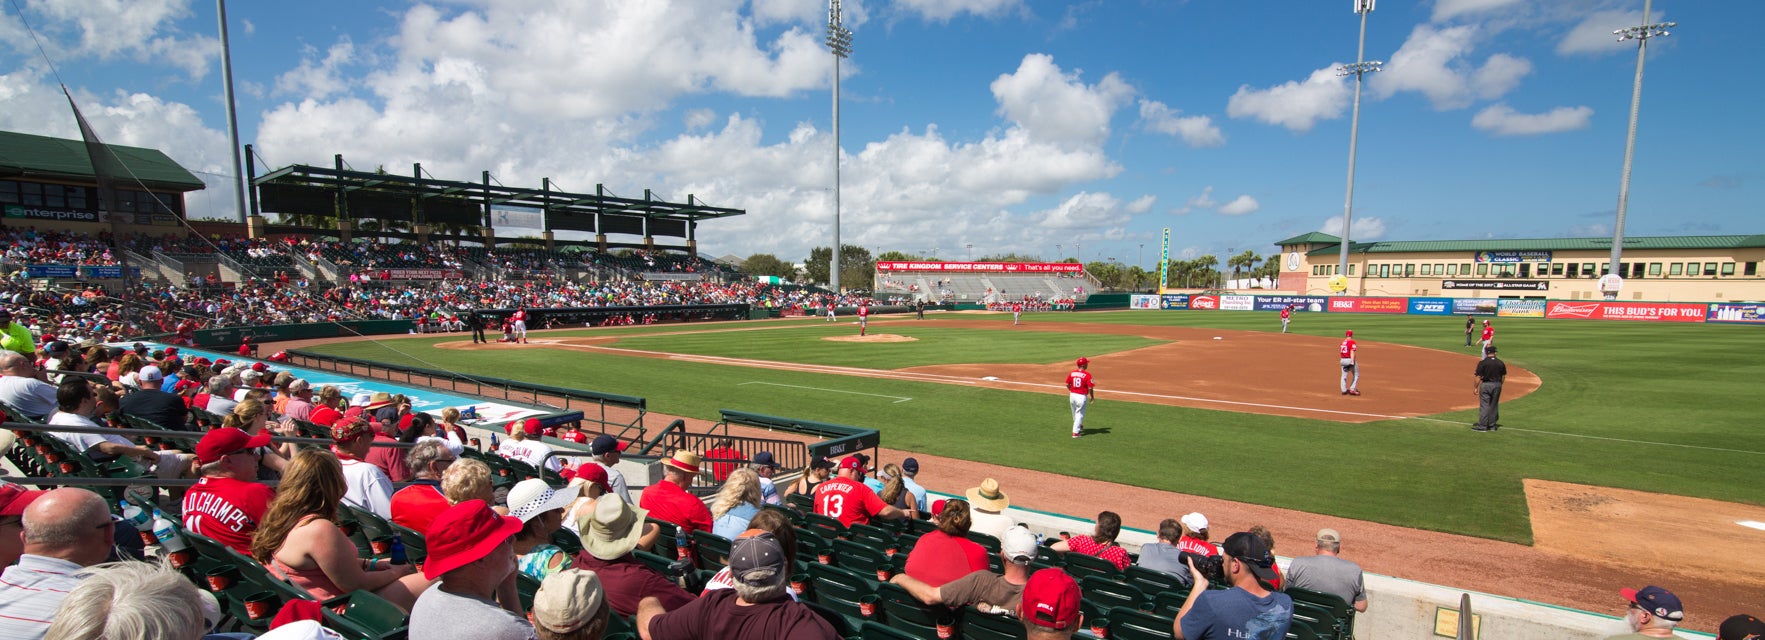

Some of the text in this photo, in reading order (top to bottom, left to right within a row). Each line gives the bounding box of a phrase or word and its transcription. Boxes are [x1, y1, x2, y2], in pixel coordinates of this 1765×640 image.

[6, 206, 95, 220] enterprise
[1554, 304, 1593, 313] Budweiser
[1603, 306, 1704, 317] THIS BUD'S FOR YOU.
[1073, 377, 1081, 388] 18
[830, 443, 846, 455] BB&T
[820, 482, 853, 494] CARPENTER
[196, 492, 248, 532] CHAMPS
[823, 494, 843, 518] 13
